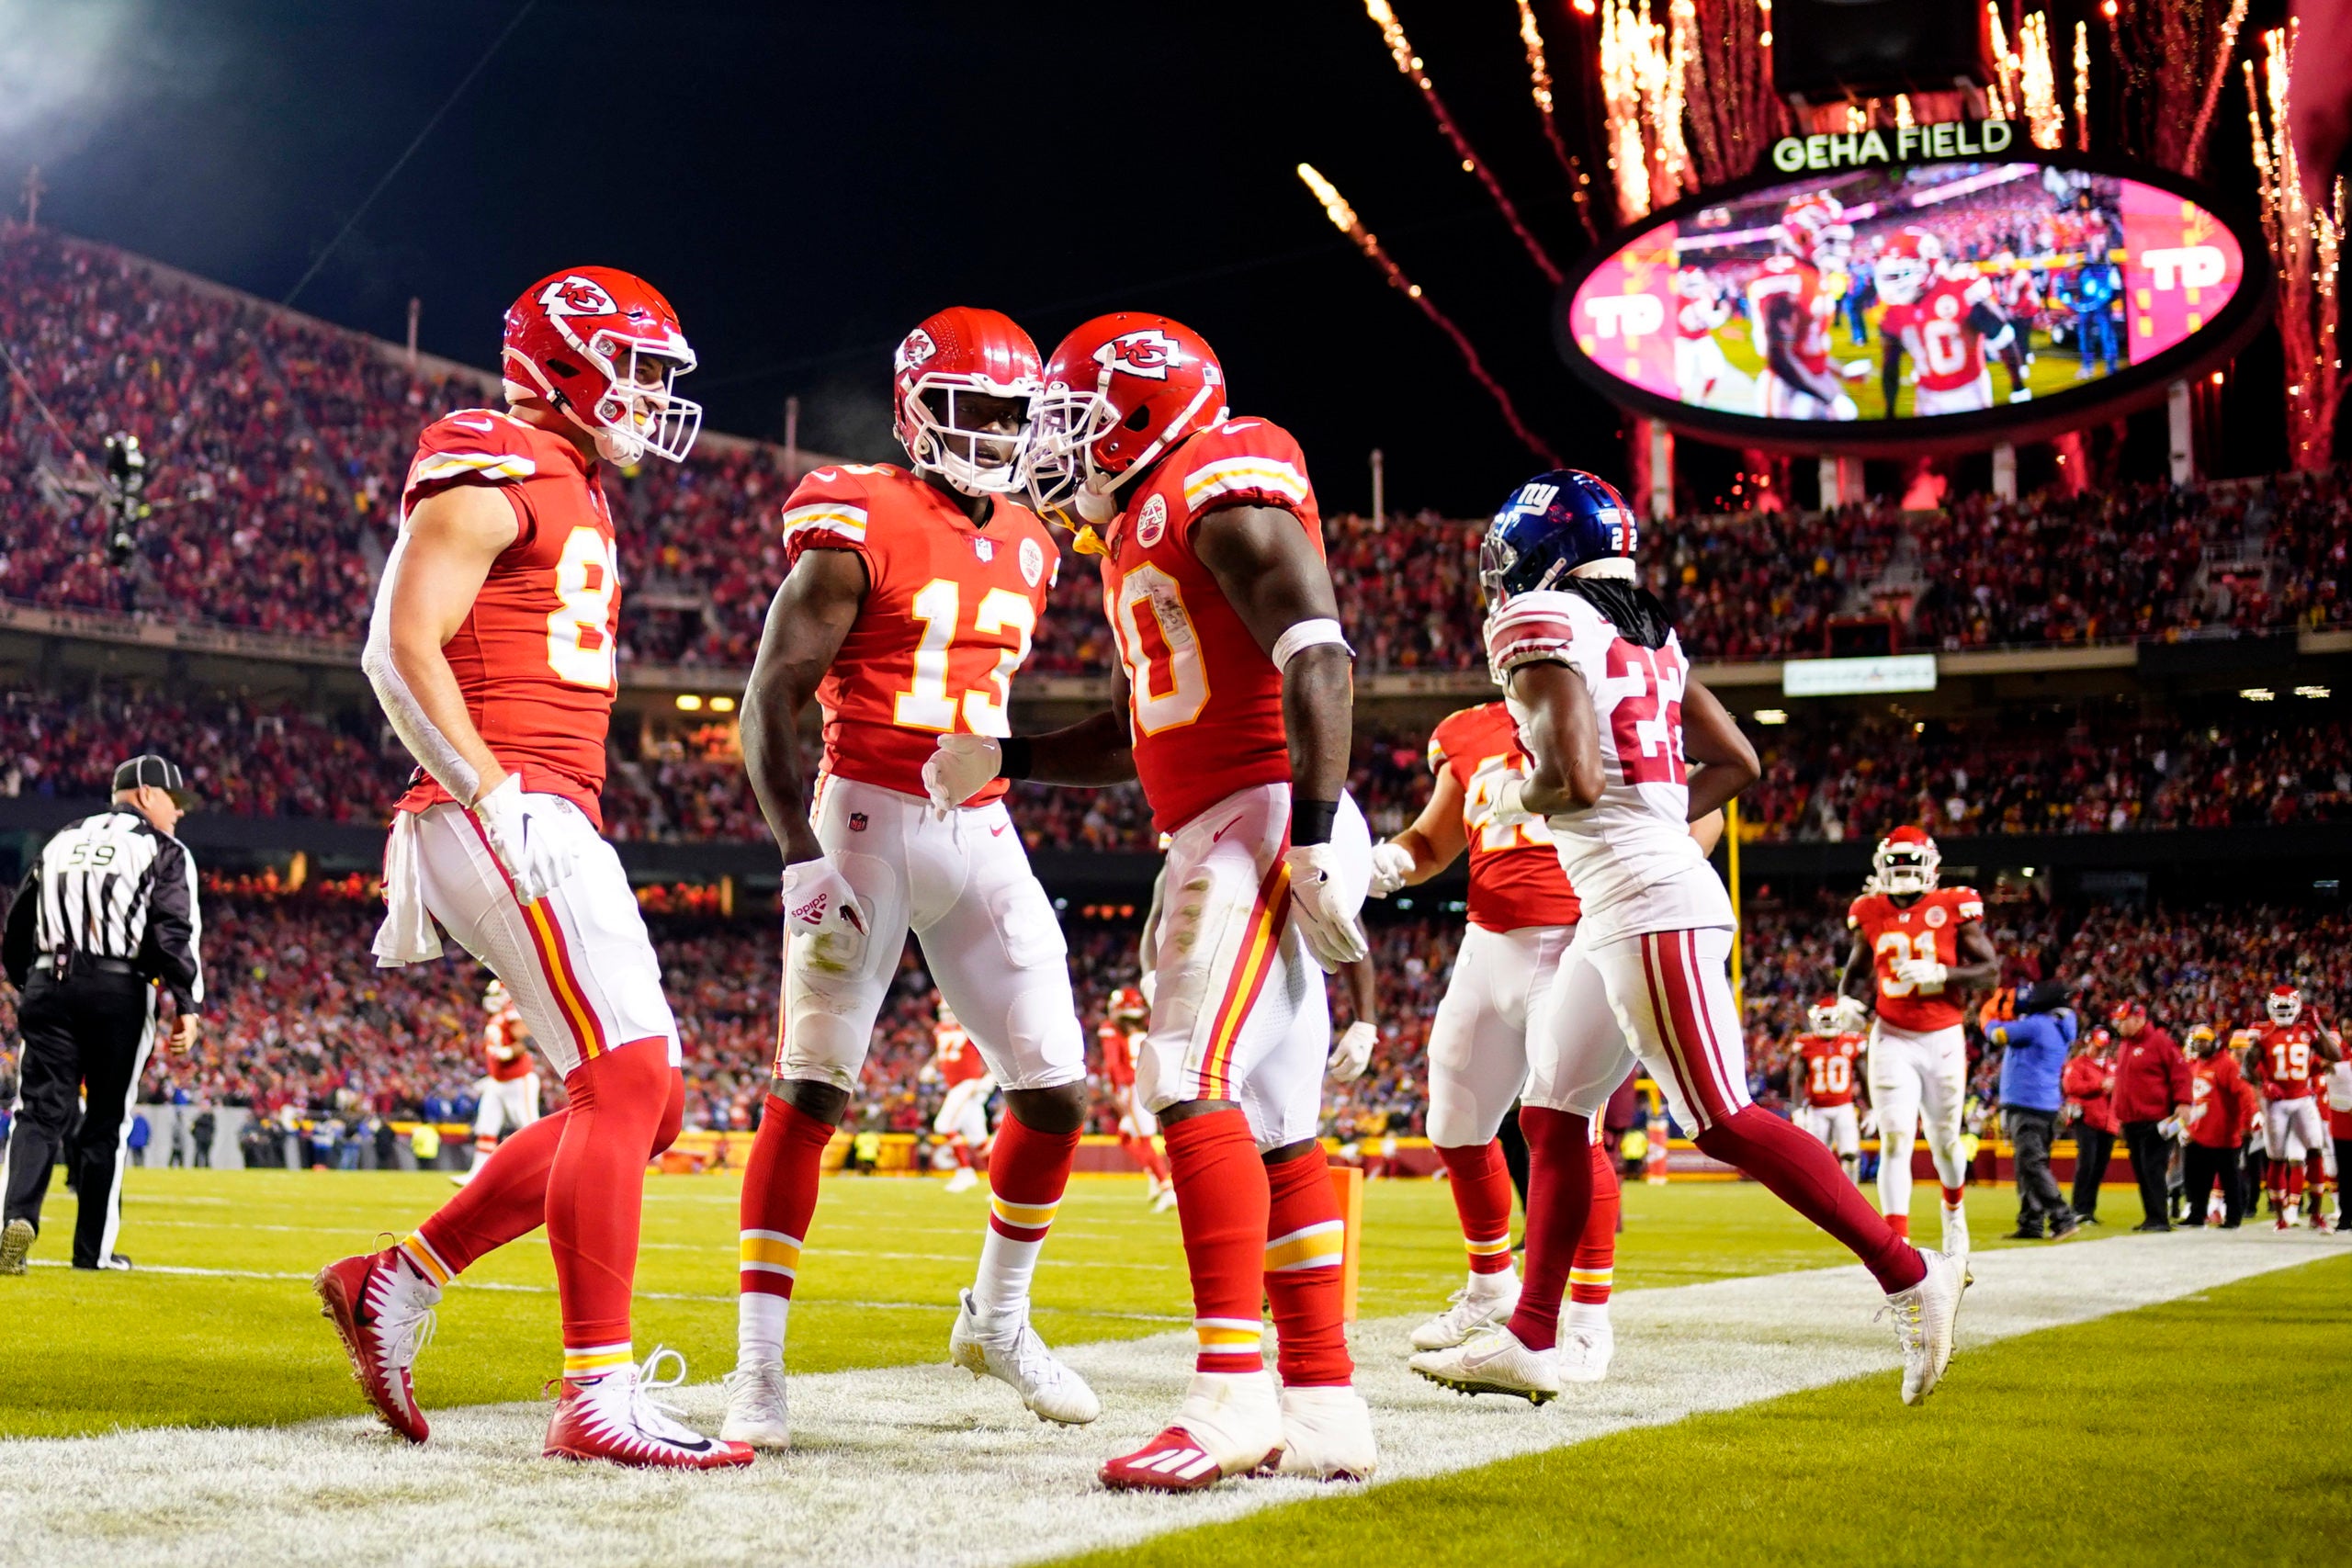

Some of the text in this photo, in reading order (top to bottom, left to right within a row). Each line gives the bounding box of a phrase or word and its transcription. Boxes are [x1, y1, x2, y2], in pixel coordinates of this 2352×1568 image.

[1772, 118, 2013, 173] GEHA FIELD
[2140, 244, 2226, 290] TD
[554, 282, 606, 313] KC
[1584, 293, 1665, 338] TD
[1112, 339, 1168, 368] KC
[1611, 526, 1638, 551] 22
[547, 525, 621, 698] 8
[893, 579, 1035, 738] 13
[1606, 637, 1689, 786] 22
[69, 843, 116, 866] 59
[791, 893, 828, 918] adidas
[1876, 931, 1946, 998] 31
[1811, 1055, 1850, 1094] 10
[2272, 1043, 2311, 1081] 19
